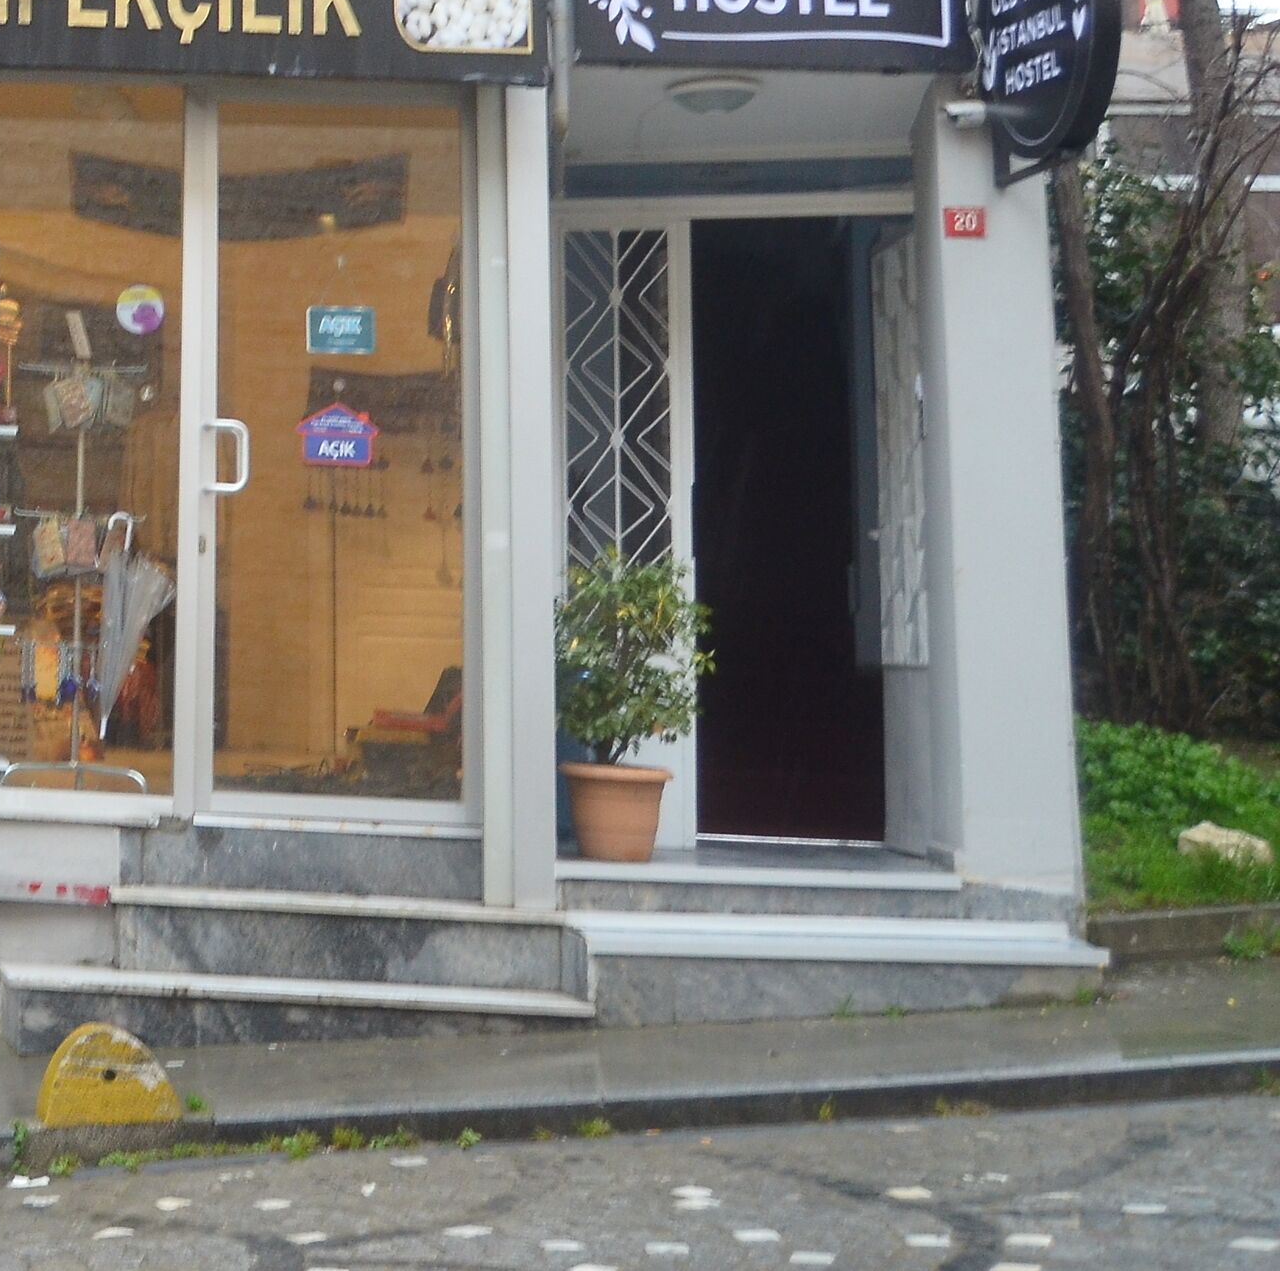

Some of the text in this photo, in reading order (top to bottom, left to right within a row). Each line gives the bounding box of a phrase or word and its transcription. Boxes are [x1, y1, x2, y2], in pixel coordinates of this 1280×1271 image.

[1005, 50, 1061, 95] HOSTEL
[954, 212, 977, 232] 20
[318, 439, 356, 461] AÇIK
